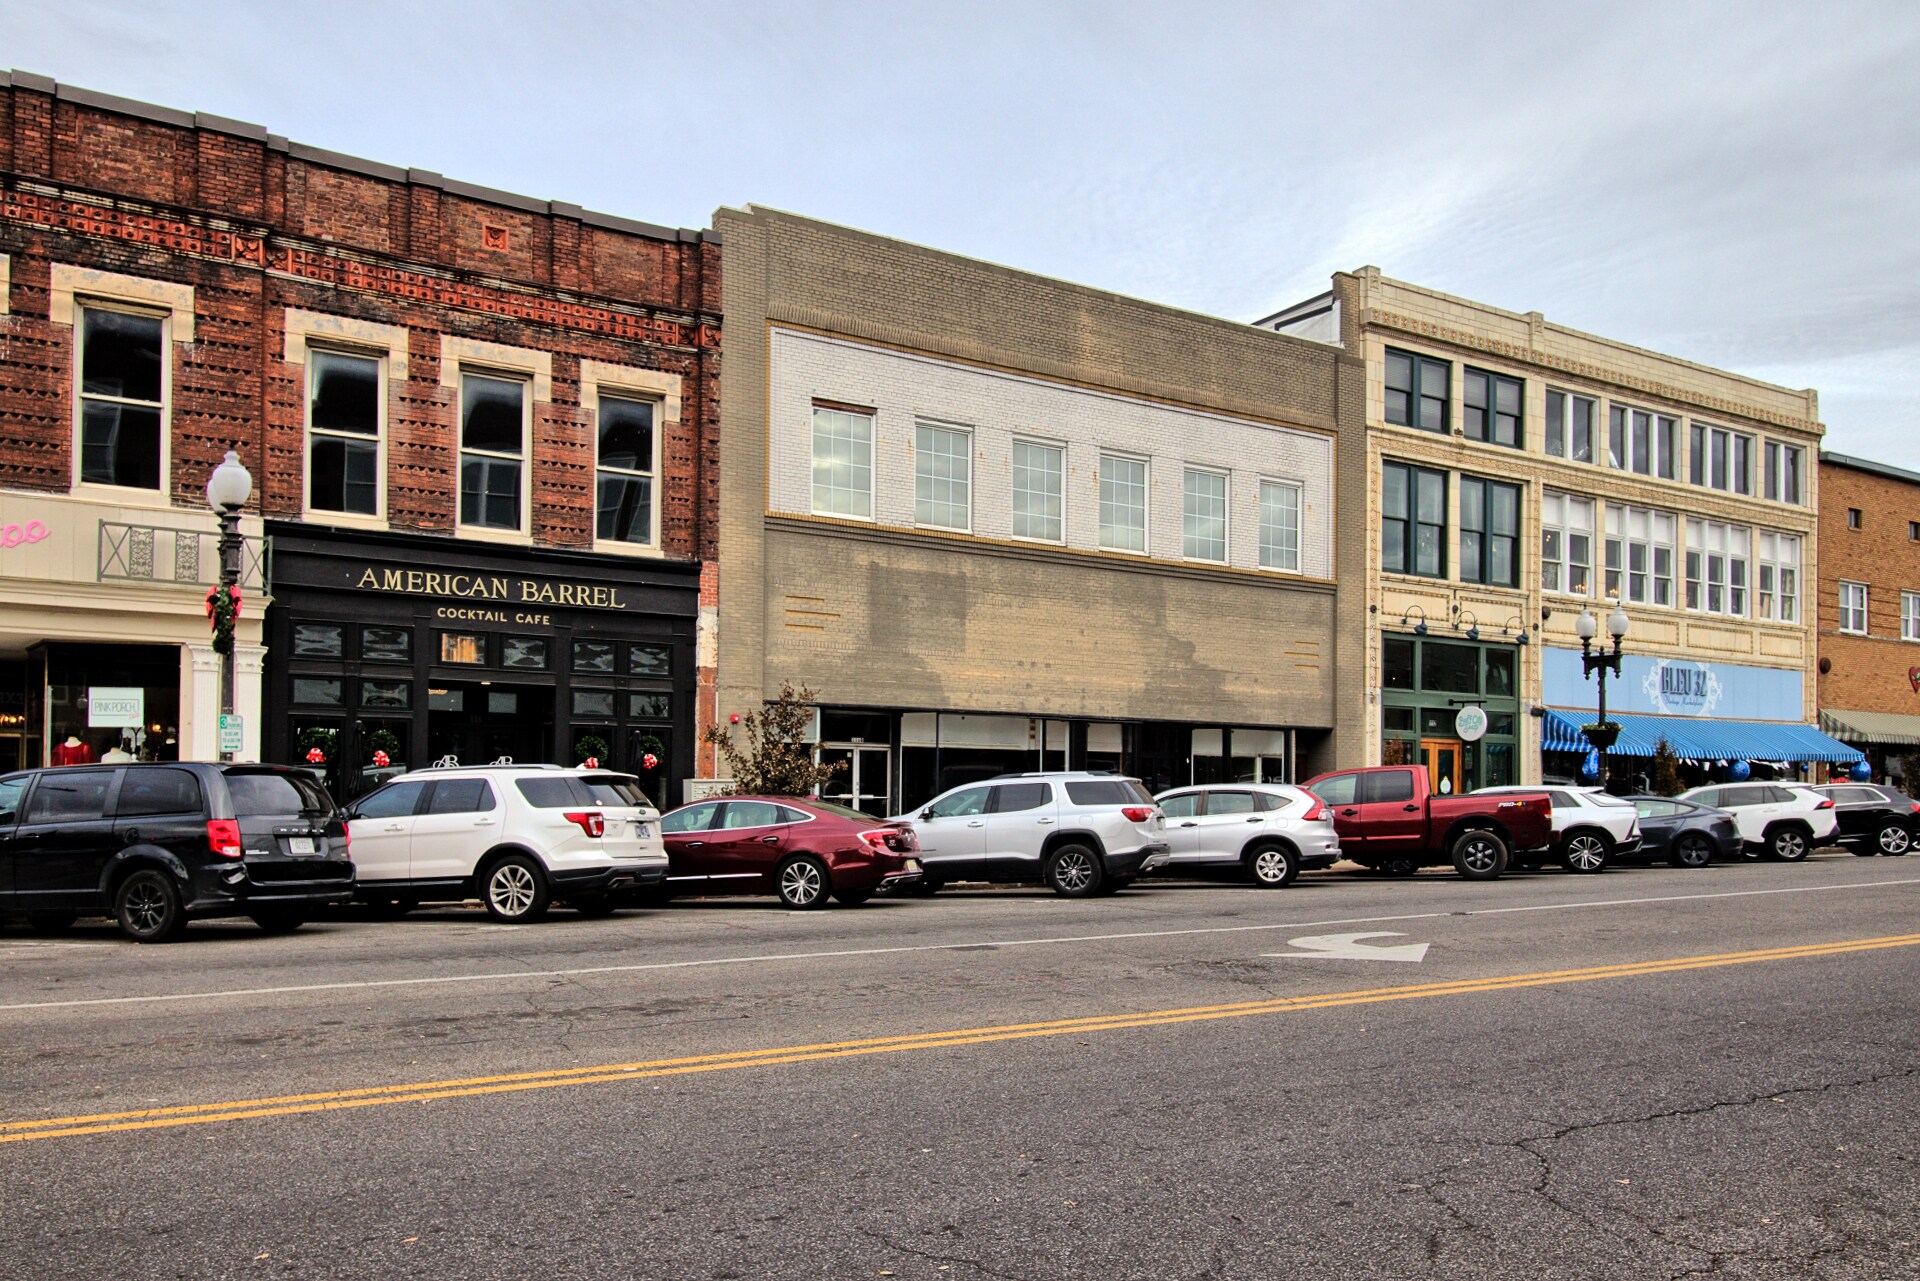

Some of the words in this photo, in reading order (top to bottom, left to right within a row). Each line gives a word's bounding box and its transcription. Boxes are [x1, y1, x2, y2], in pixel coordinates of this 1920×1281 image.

[356, 567, 509, 599] AMERICAN
[520, 580, 627, 610] BARREL
[437, 607, 508, 622] COCKTAIL
[516, 613, 551, 625] CAFE
[1660, 666, 1691, 696] BLEU
[94, 702, 111, 713] PINK
[111, 702, 137, 713] PORCH
